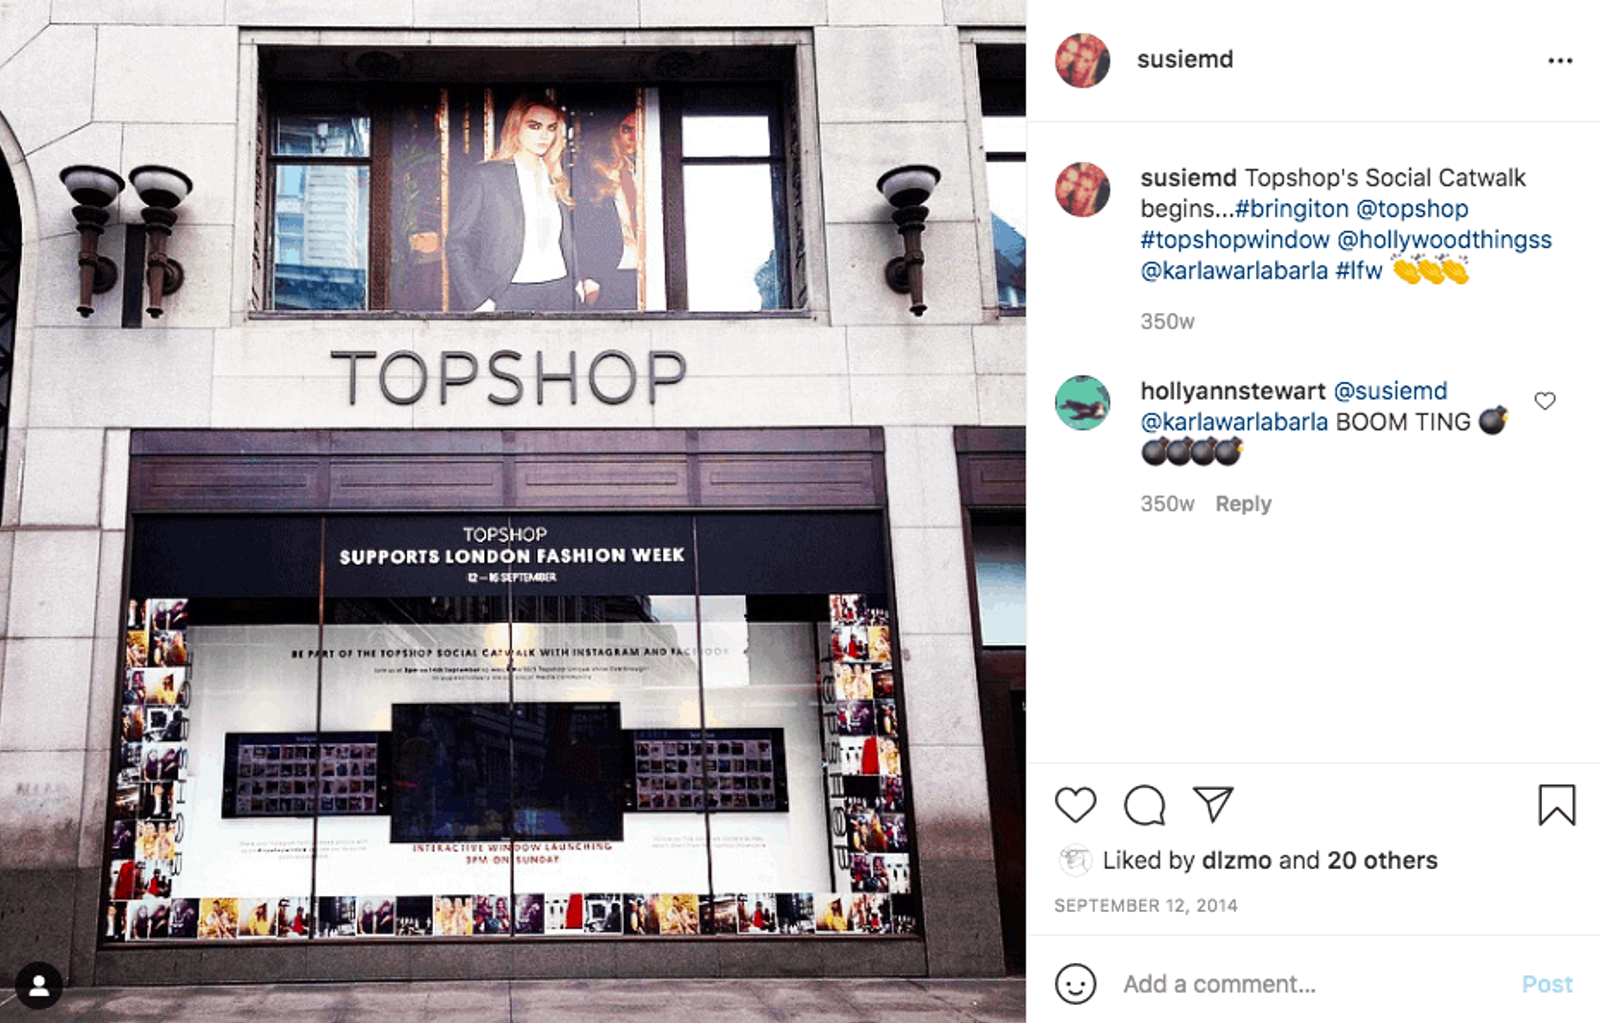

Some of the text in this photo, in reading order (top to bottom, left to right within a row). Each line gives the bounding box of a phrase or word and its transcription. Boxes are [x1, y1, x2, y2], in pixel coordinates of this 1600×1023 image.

[330, 349, 686, 407] TOPSHOP
[462, 525, 548, 543] TOPSHOP
[339, 546, 685, 565] SUPPORTS LONDON FASHION WEEK
[500, 572, 557, 583] SEPTEMBER
[291, 646, 729, 659] BE PART OF THE TOPSHOP SOCIAL CATWALK WITH INSTAGRAM AND FACEOOK
[412, 842, 613, 853] INTERACTIVE WINDOW LAUNCHING
[516, 855, 560, 864] SUNDAY
